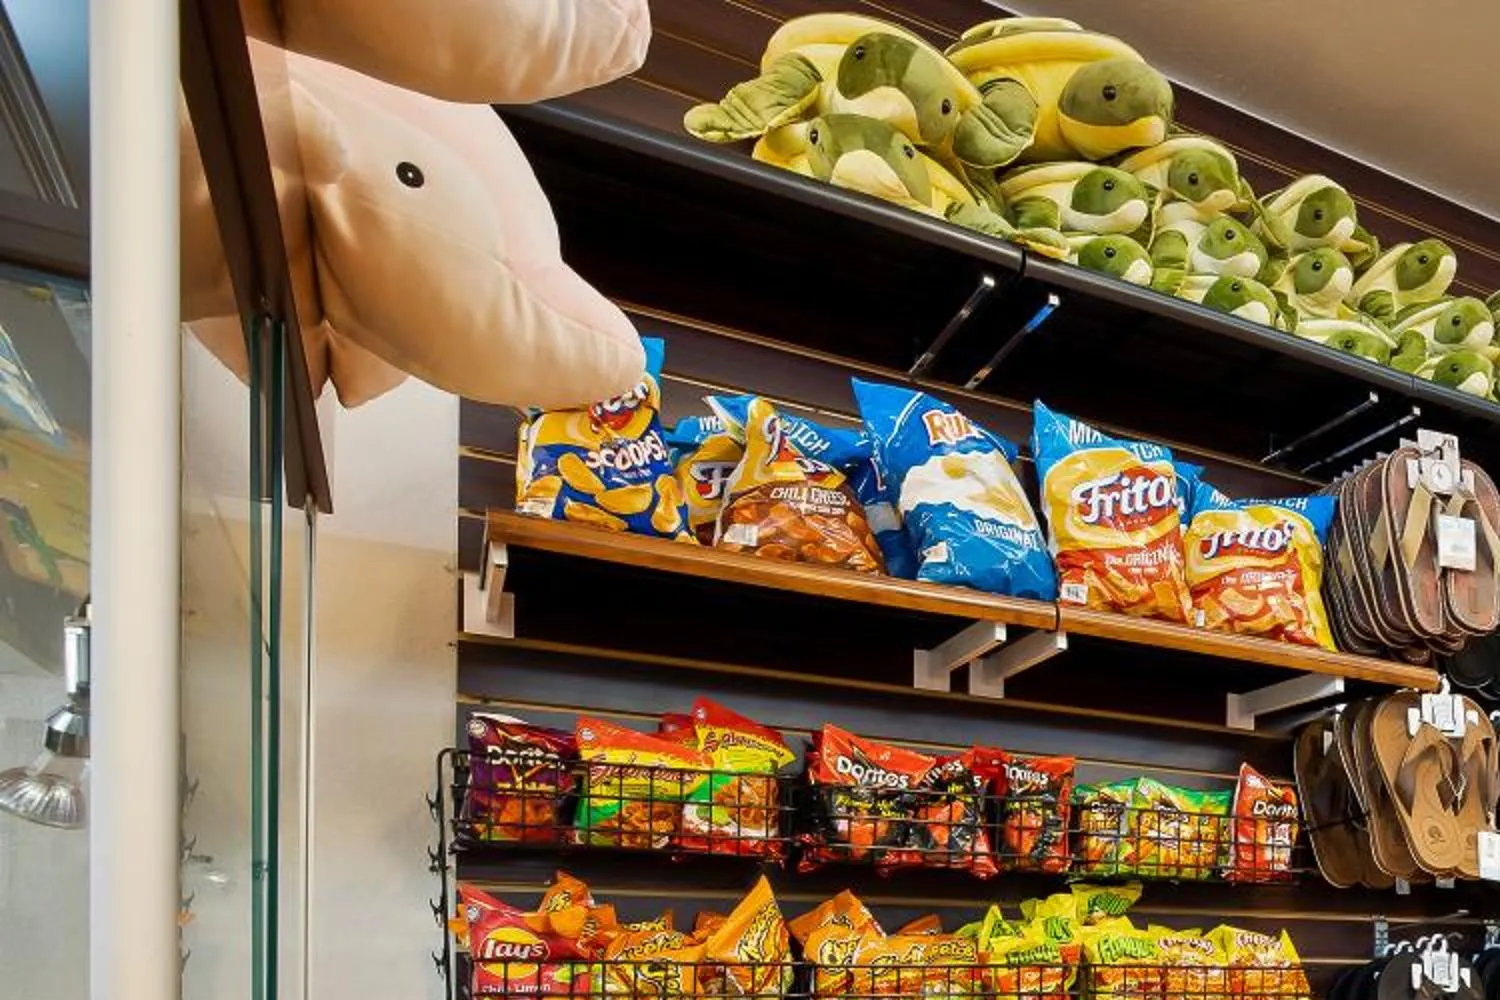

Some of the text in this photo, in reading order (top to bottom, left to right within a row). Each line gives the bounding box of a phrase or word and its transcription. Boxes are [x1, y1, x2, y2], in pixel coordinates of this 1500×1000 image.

[586, 429, 668, 471] SCOOPS!
[974, 519, 1040, 553] ORIGINAL
[836, 754, 909, 789] Doritos
[1002, 764, 1049, 785] Doritos
